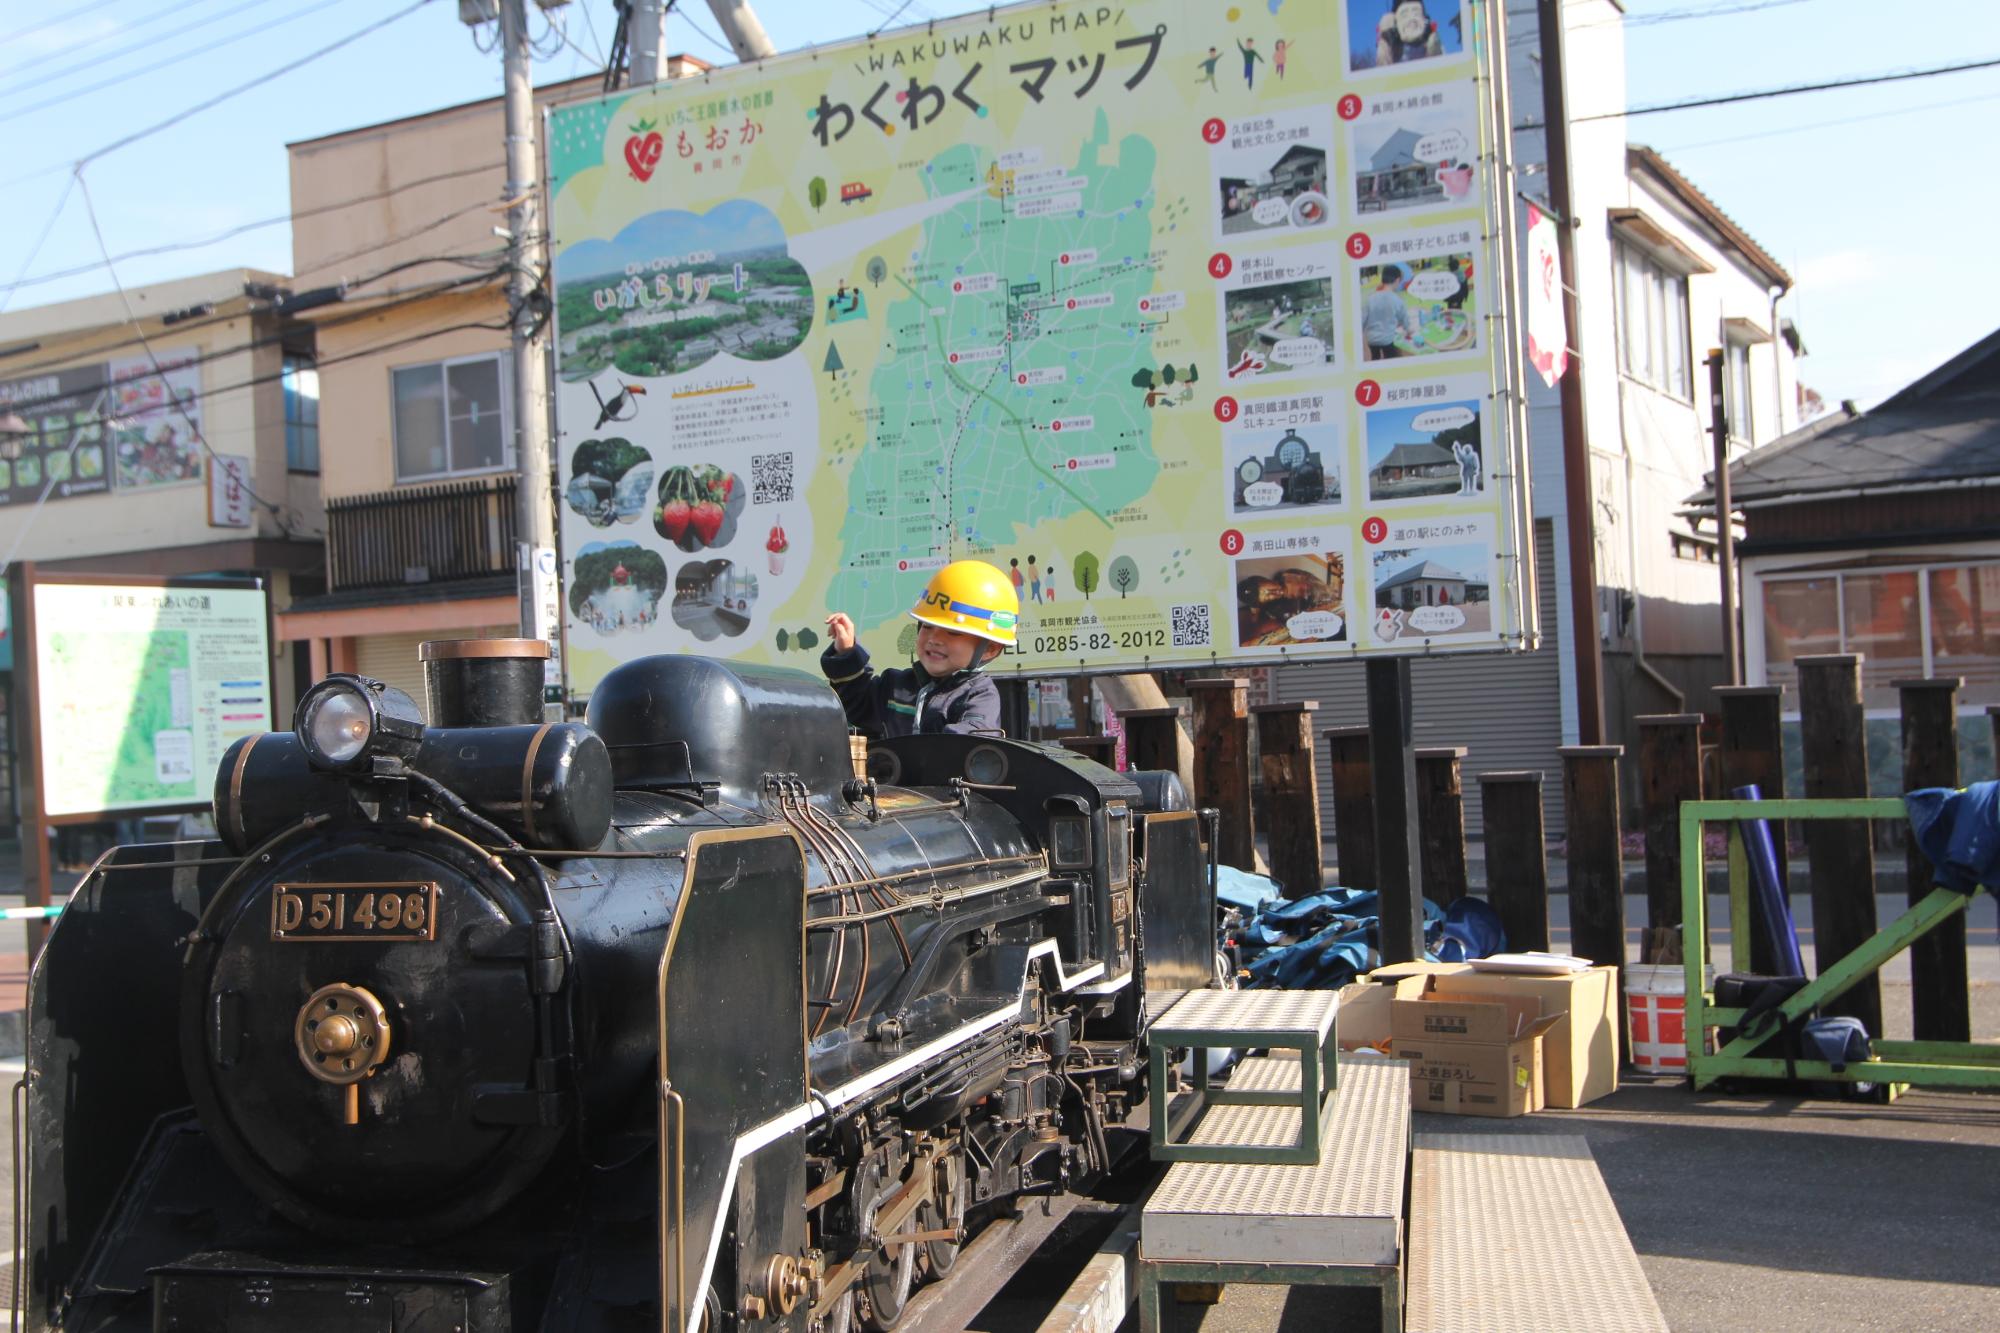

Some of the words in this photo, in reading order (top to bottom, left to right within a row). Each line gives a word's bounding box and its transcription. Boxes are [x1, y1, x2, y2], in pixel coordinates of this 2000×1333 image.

[869, 24, 1034, 72] WAKUWAKU
[1051, 8, 1111, 35] MAP
[807, 62, 988, 147] わくわく
[1010, 24, 1167, 104] マップ
[1344, 99, 1355, 116] 3
[677, 118, 763, 158] もおか
[1208, 123, 1219, 140] 2
[1353, 237, 1363, 254] 5
[1378, 231, 1471, 256] 真岡駅子ども広場
[1215, 258, 1225, 274] 4
[1241, 257, 1274, 272] 根本山
[1241, 264, 1326, 285] 自然観察センター
[594, 263, 749, 311] いがしらリゾート
[1363, 385, 1373, 402] 7
[1387, 384, 1447, 401] 桜町陣屋跡
[1221, 401, 1231, 417] 6
[1244, 411, 1321, 429] SLキューロク館
[1369, 522, 1379, 539] 9
[1394, 524, 1477, 541] 道の駅にのみや
[1227, 535, 1237, 550] 8
[1252, 536, 1321, 552] 高田山専修寺
[926, 591, 951, 611] JR
[1040, 615, 1098, 628] 真岡市観光協会
[1003, 639, 1027, 655] EL
[1035, 630, 1165, 653] 0285-82-2012
[279, 893, 345, 931] D51
[353, 893, 426, 930] 498
